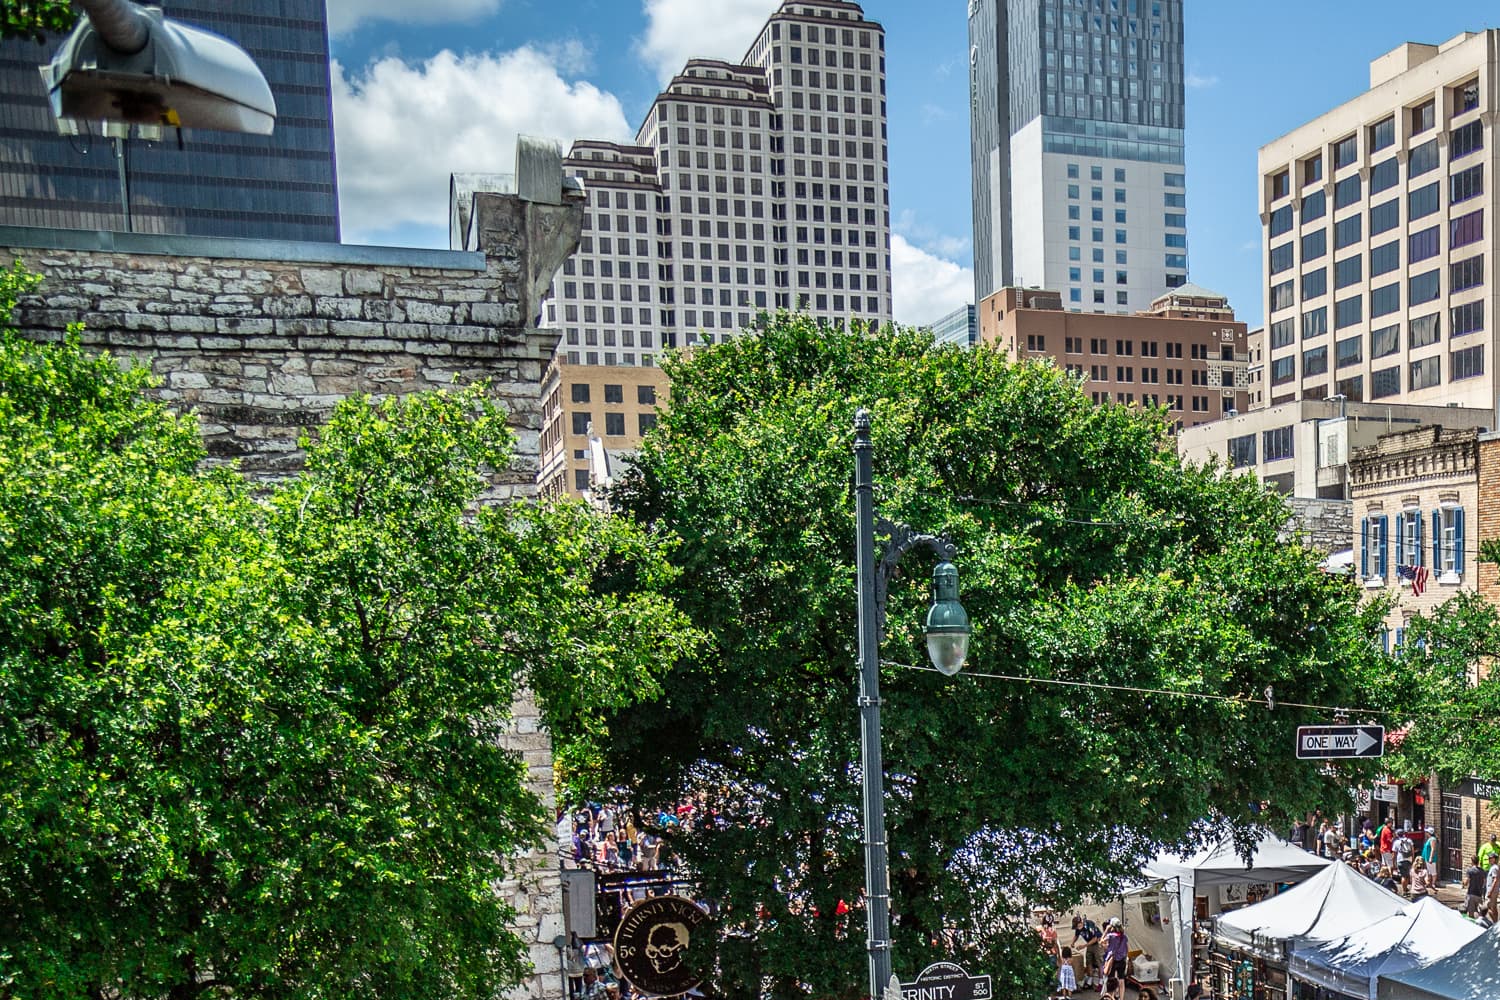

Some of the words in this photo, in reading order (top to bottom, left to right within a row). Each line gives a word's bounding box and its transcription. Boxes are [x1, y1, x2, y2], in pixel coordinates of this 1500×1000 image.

[1306, 736, 1329, 749] ONE
[1334, 735, 1358, 748] WAY
[974, 982, 985, 990] ST
[972, 988, 988, 996] 500
